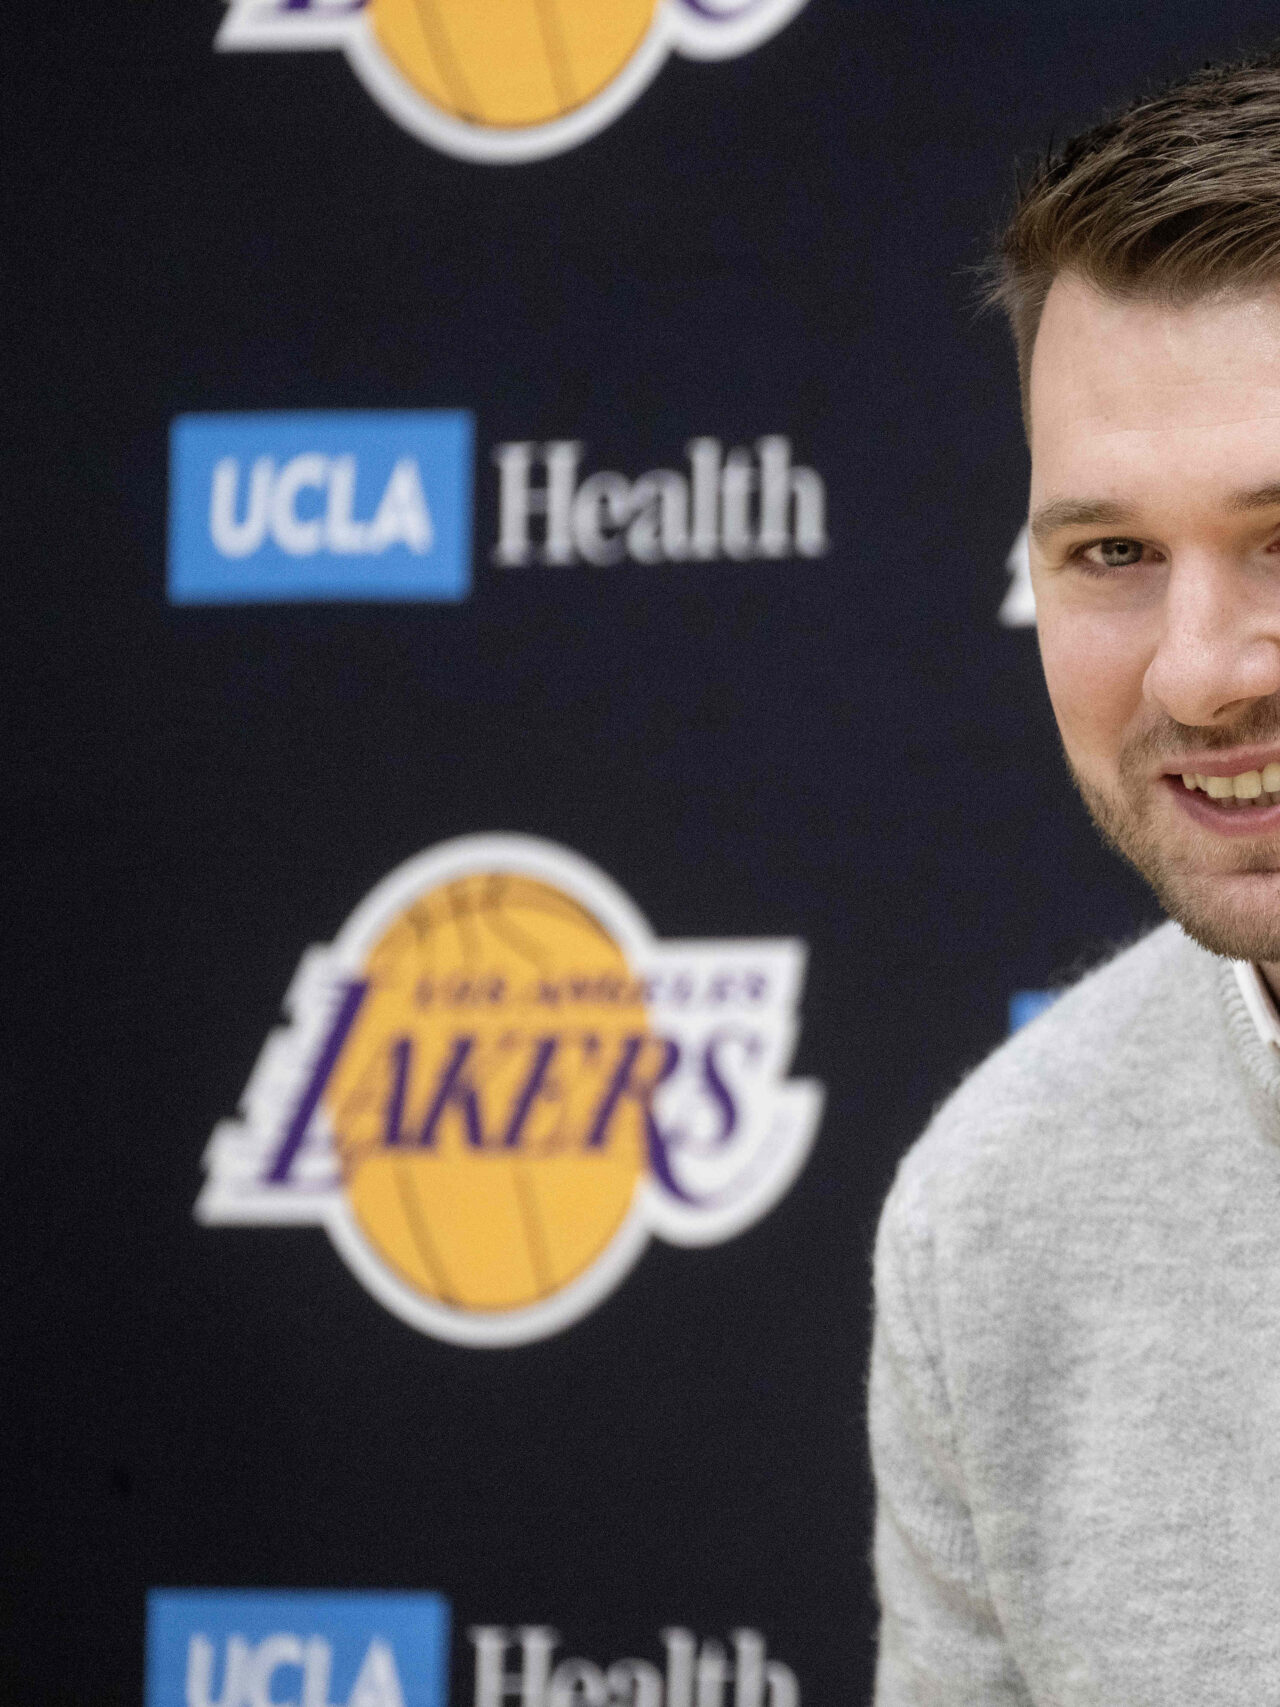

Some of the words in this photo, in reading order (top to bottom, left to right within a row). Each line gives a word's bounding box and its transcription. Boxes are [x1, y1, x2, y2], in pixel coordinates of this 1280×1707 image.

[209, 450, 434, 559] UCLA
[492, 434, 828, 567] Health
[260, 977, 785, 1208] LAKERS
[185, 1632, 408, 1707] UCLA
